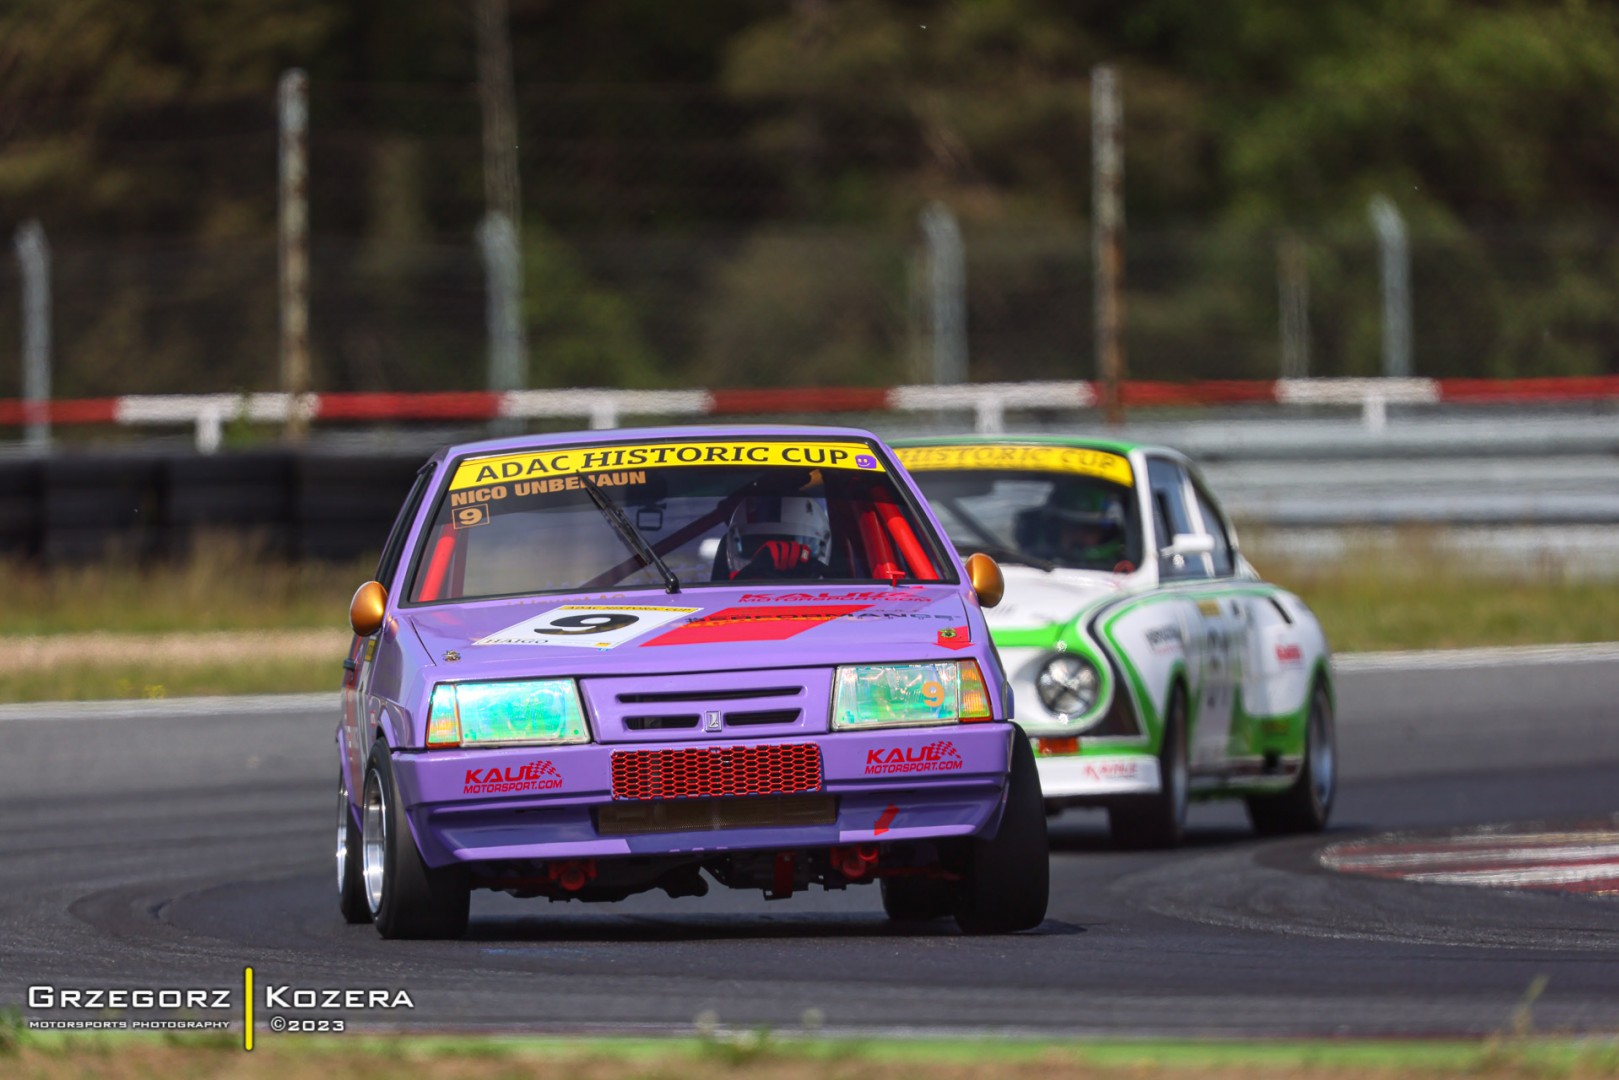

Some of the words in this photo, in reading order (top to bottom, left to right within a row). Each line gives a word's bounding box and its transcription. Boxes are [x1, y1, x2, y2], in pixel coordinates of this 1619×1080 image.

[475, 455, 570, 482] ADAC
[581, 446, 769, 469] HISTORIC
[781, 447, 848, 464] CUP
[451, 485, 508, 507] NICO
[458, 508, 483, 525] 9
[534, 613, 640, 635] 9
[921, 681, 945, 707] 9
[865, 744, 940, 764] KAUL
[465, 765, 540, 784] KAUL
[865, 760, 963, 775] MOTORSPORT.COM
[463, 779, 563, 794] MOTORSPORT.COM
